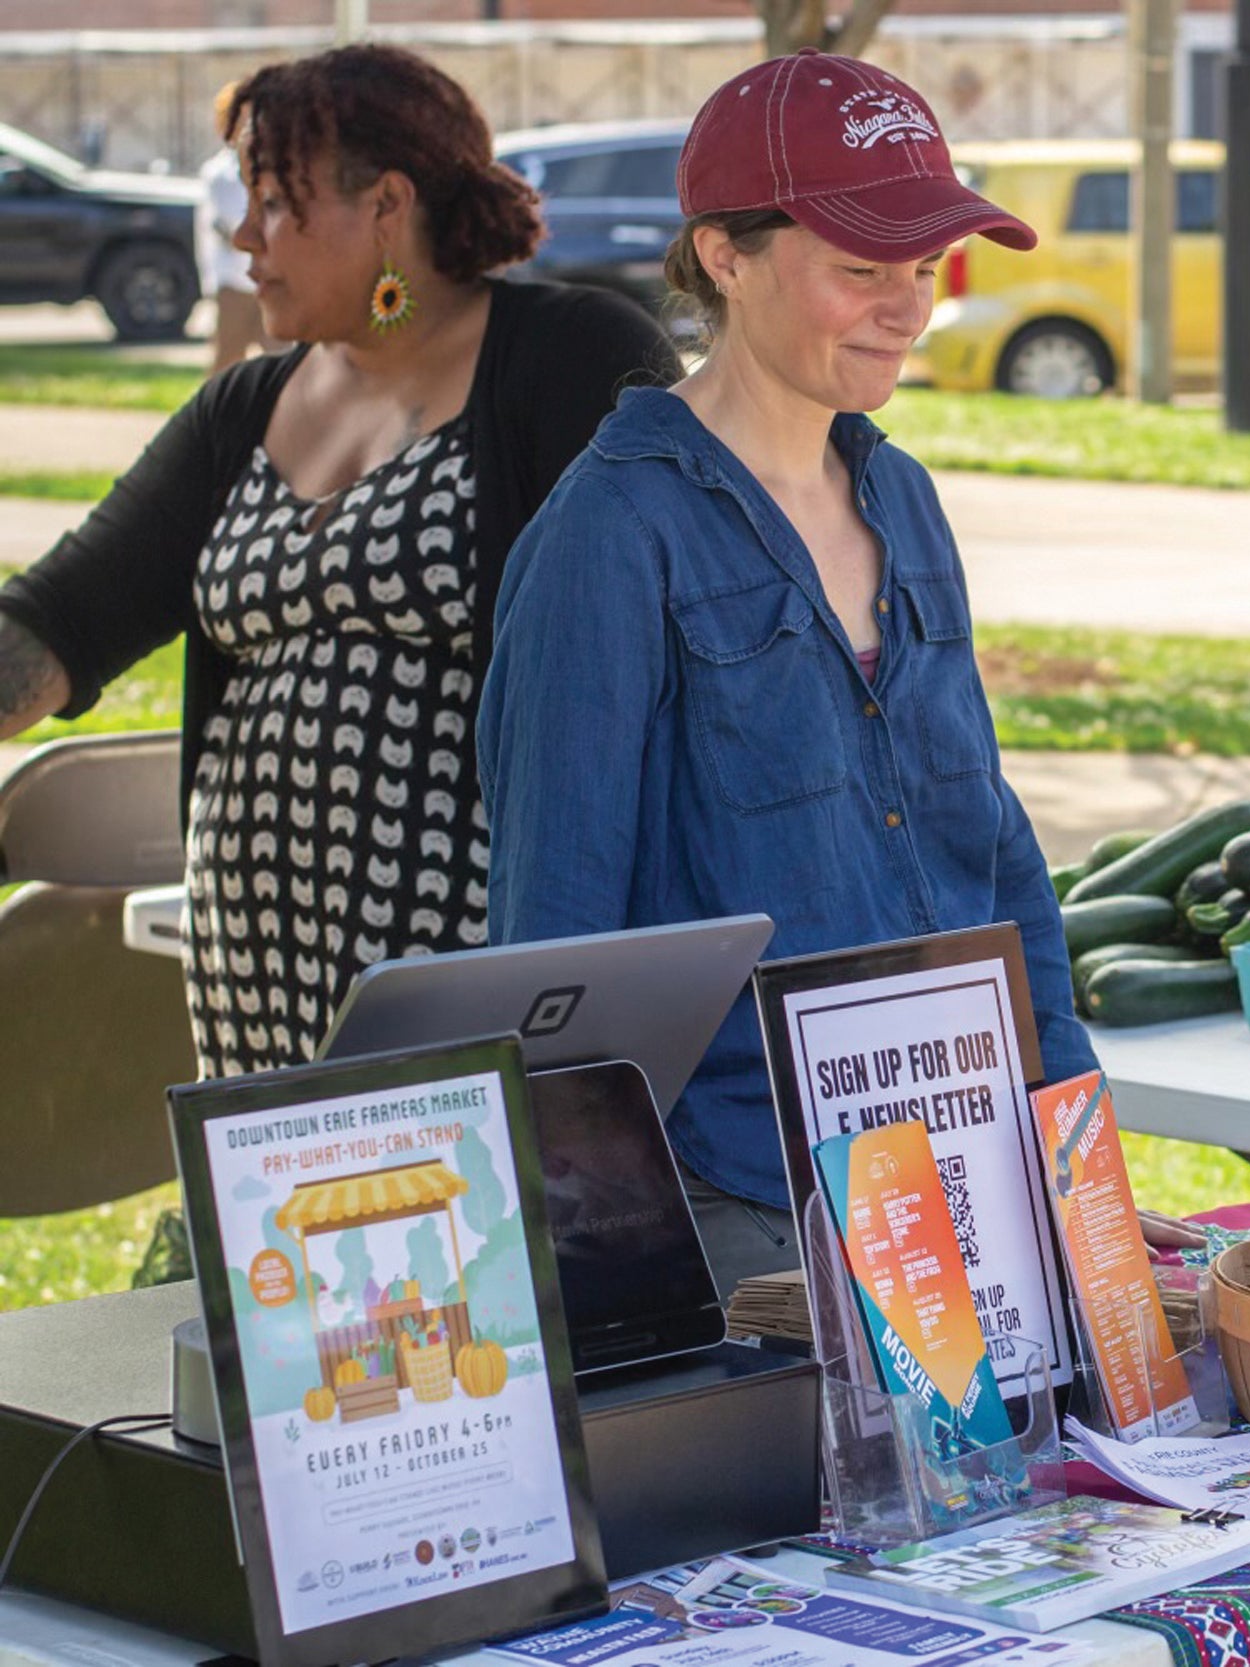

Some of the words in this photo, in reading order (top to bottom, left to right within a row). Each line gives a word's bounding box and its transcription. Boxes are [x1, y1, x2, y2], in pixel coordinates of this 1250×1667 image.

[842, 111, 903, 147] Niagara
[816, 1053, 870, 1100] SIGN
[873, 1048, 902, 1089] UP
[908, 1039, 951, 1083] FOR
[954, 1031, 998, 1074] OUR
[227, 1116, 319, 1149] DOWNTOWN
[324, 1109, 357, 1132] ERIE
[361, 1097, 427, 1126] FARMERS
[431, 1087, 487, 1113] MARKET
[1058, 1089, 1088, 1143] SUMMER
[1078, 1108, 1105, 1162] MUSIC
[263, 1132, 413, 1175] PAY-WHAT-YOU-CAN
[419, 1122, 464, 1148] STAND
[988, 1284, 1005, 1308] UP
[996, 1307, 1021, 1333] FOR
[881, 1326, 936, 1405] MOVIE
[307, 1442, 368, 1472] EVERY
[379, 1423, 449, 1456] FRIDAY
[336, 1472, 367, 1489] JULY
[375, 1464, 389, 1480] 12
[408, 1447, 466, 1472] OCTOBER
[473, 1441, 488, 1457] 25
[869, 1536, 1031, 1583] LET'S
[915, 1551, 1066, 1593] RIDE
